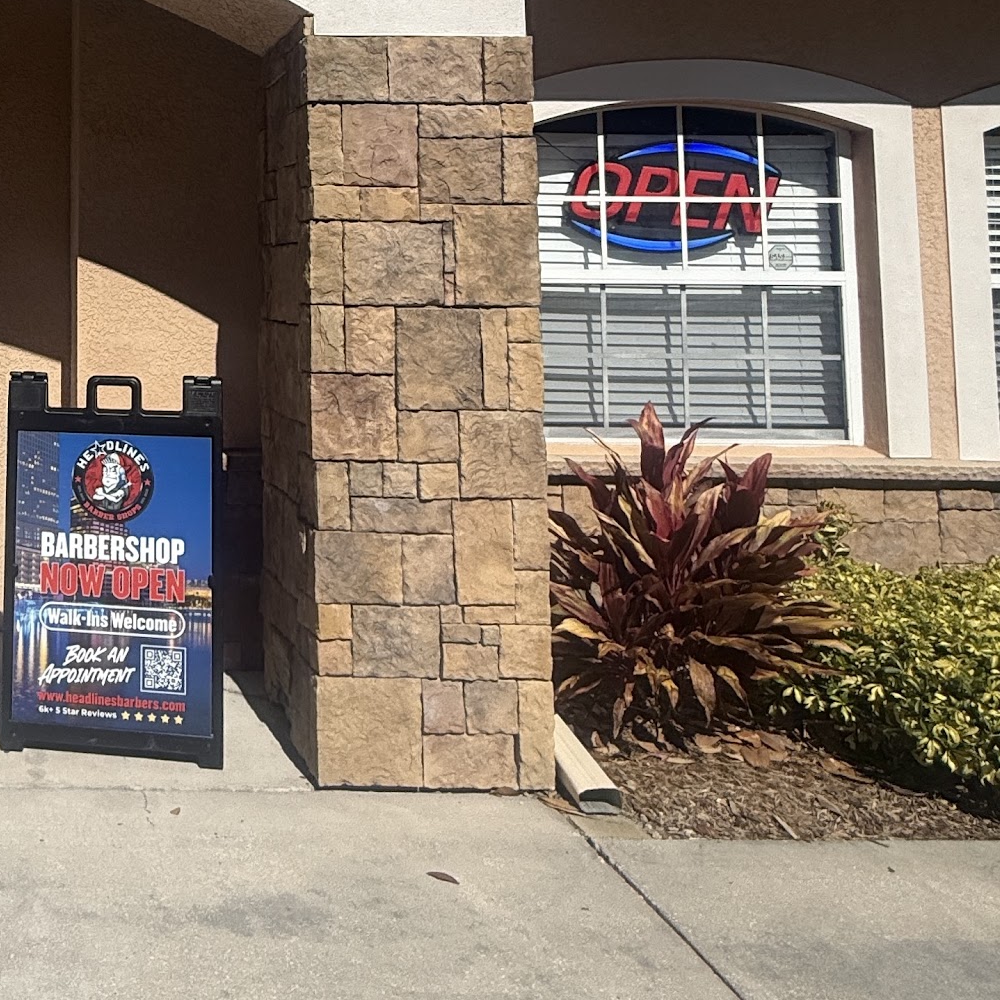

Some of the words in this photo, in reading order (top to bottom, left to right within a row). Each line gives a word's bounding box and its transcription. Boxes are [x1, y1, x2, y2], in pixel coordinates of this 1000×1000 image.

[570, 161, 779, 233] OPEN
[40, 531, 185, 565] BARBERSHOP
[39, 560, 106, 598] NOW
[111, 565, 186, 603] OPEN
[48, 607, 109, 628] Walk-Ins
[110, 611, 178, 632] Welcome
[62, 644, 106, 666] BOOK
[107, 646, 130, 664] AN
[37, 663, 136, 686] APPOINTMENT
[36, 690, 186, 713] www.headlinesbarbers.com
[55, 705, 61, 714] 5
[62, 706, 79, 716] Star
[81, 708, 118, 719] Reviews
